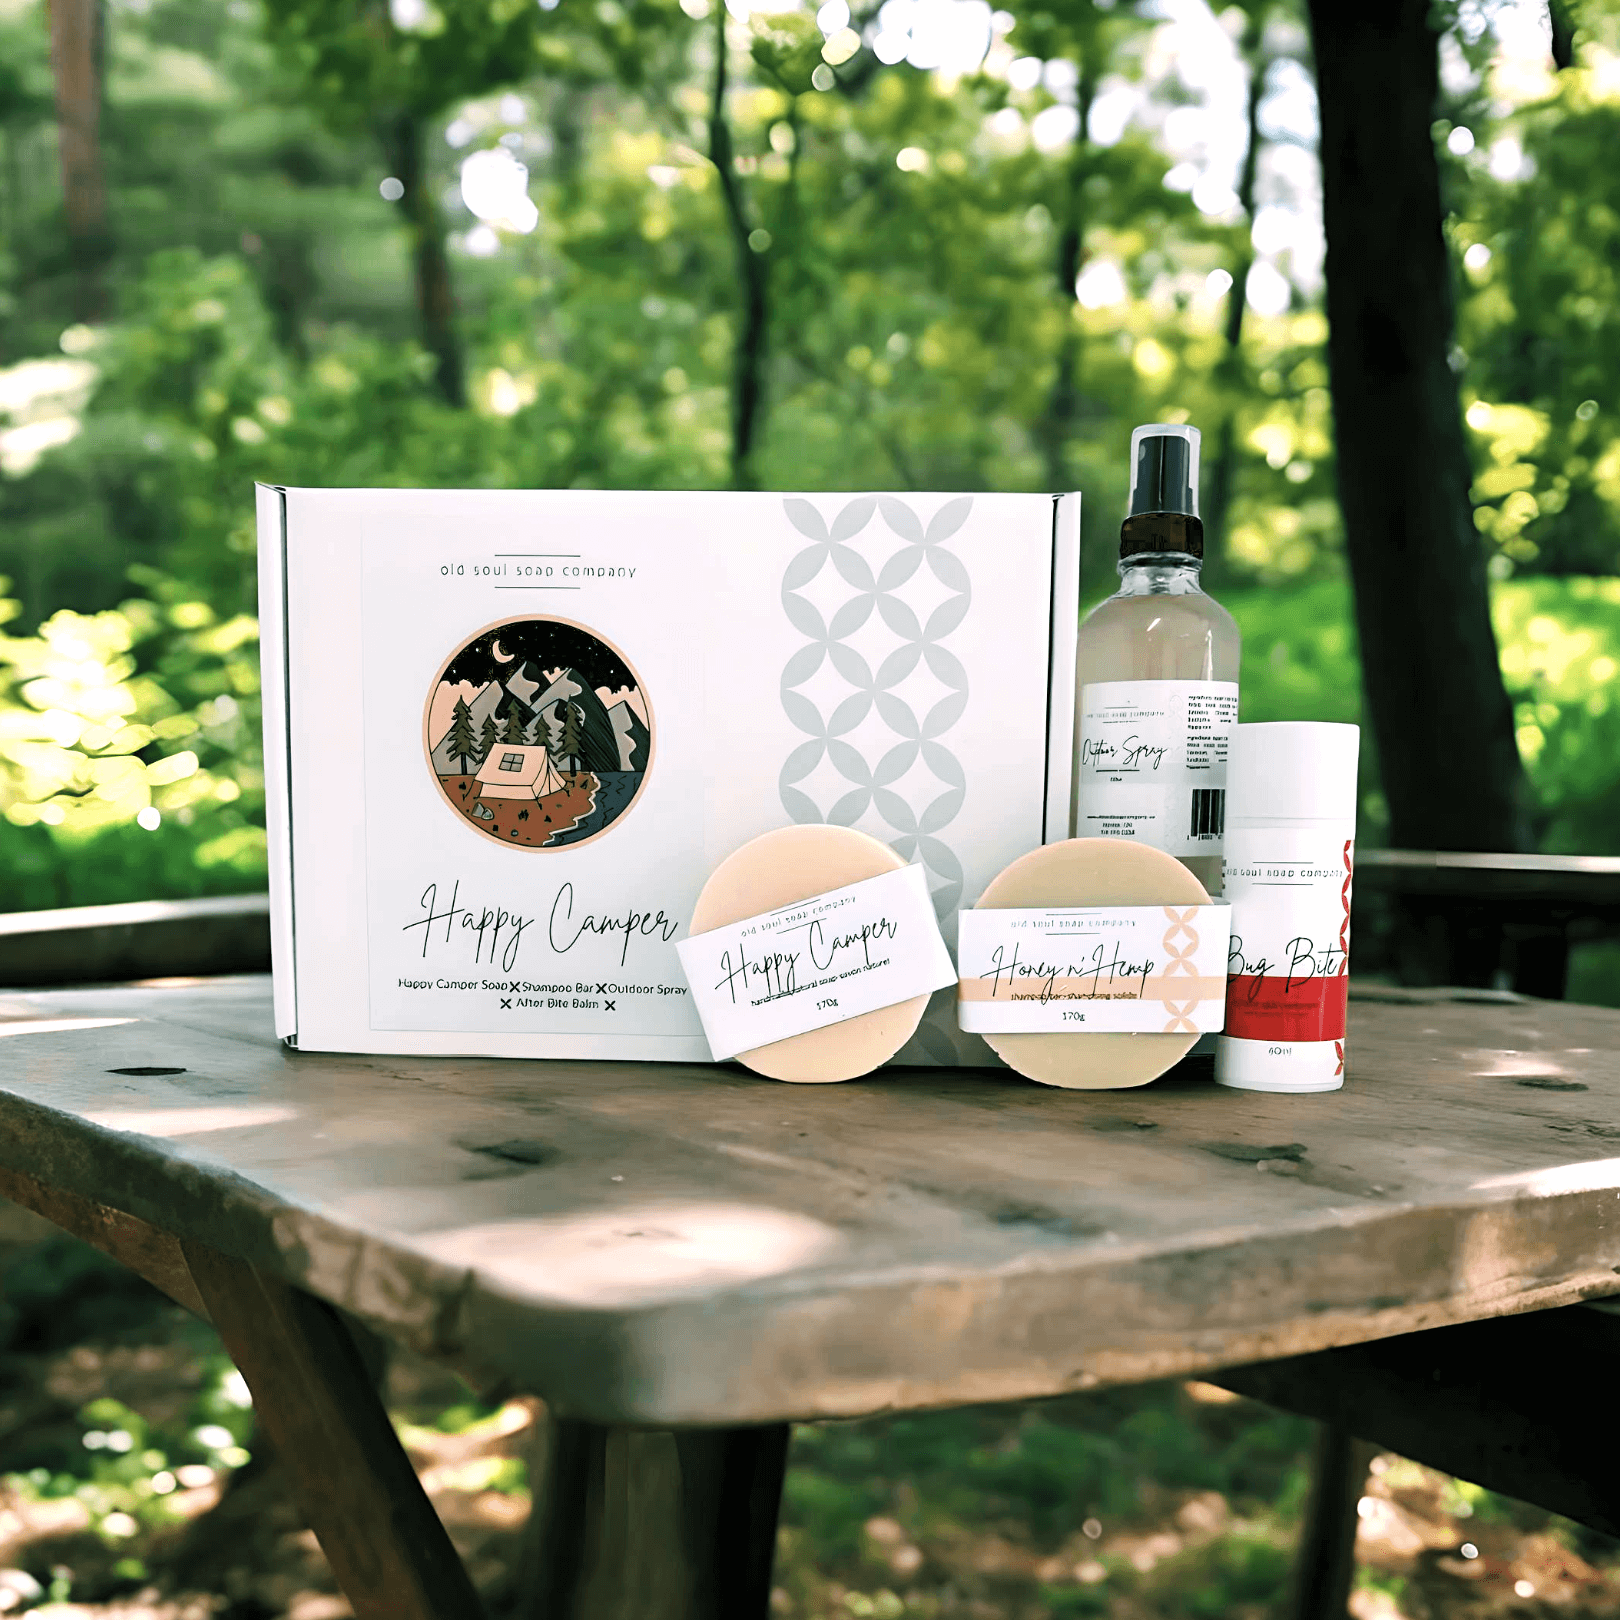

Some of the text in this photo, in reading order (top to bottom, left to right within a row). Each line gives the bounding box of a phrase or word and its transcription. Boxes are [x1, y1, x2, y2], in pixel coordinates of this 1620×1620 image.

[441, 563, 637, 578] old soul soap company
[1122, 735, 1168, 770] Spray
[403, 880, 678, 972] Happy Camper
[714, 917, 897, 1004] Happy Camper
[980, 942, 1063, 1005] Honey
[1079, 941, 1155, 999] Hemp
[1228, 934, 1345, 1001] Bug Bite
[398, 978, 687, 996] Happy Camper Soap Shampoo Bar Outdoor Spray
[1062, 1011, 1086, 1022] 170g
